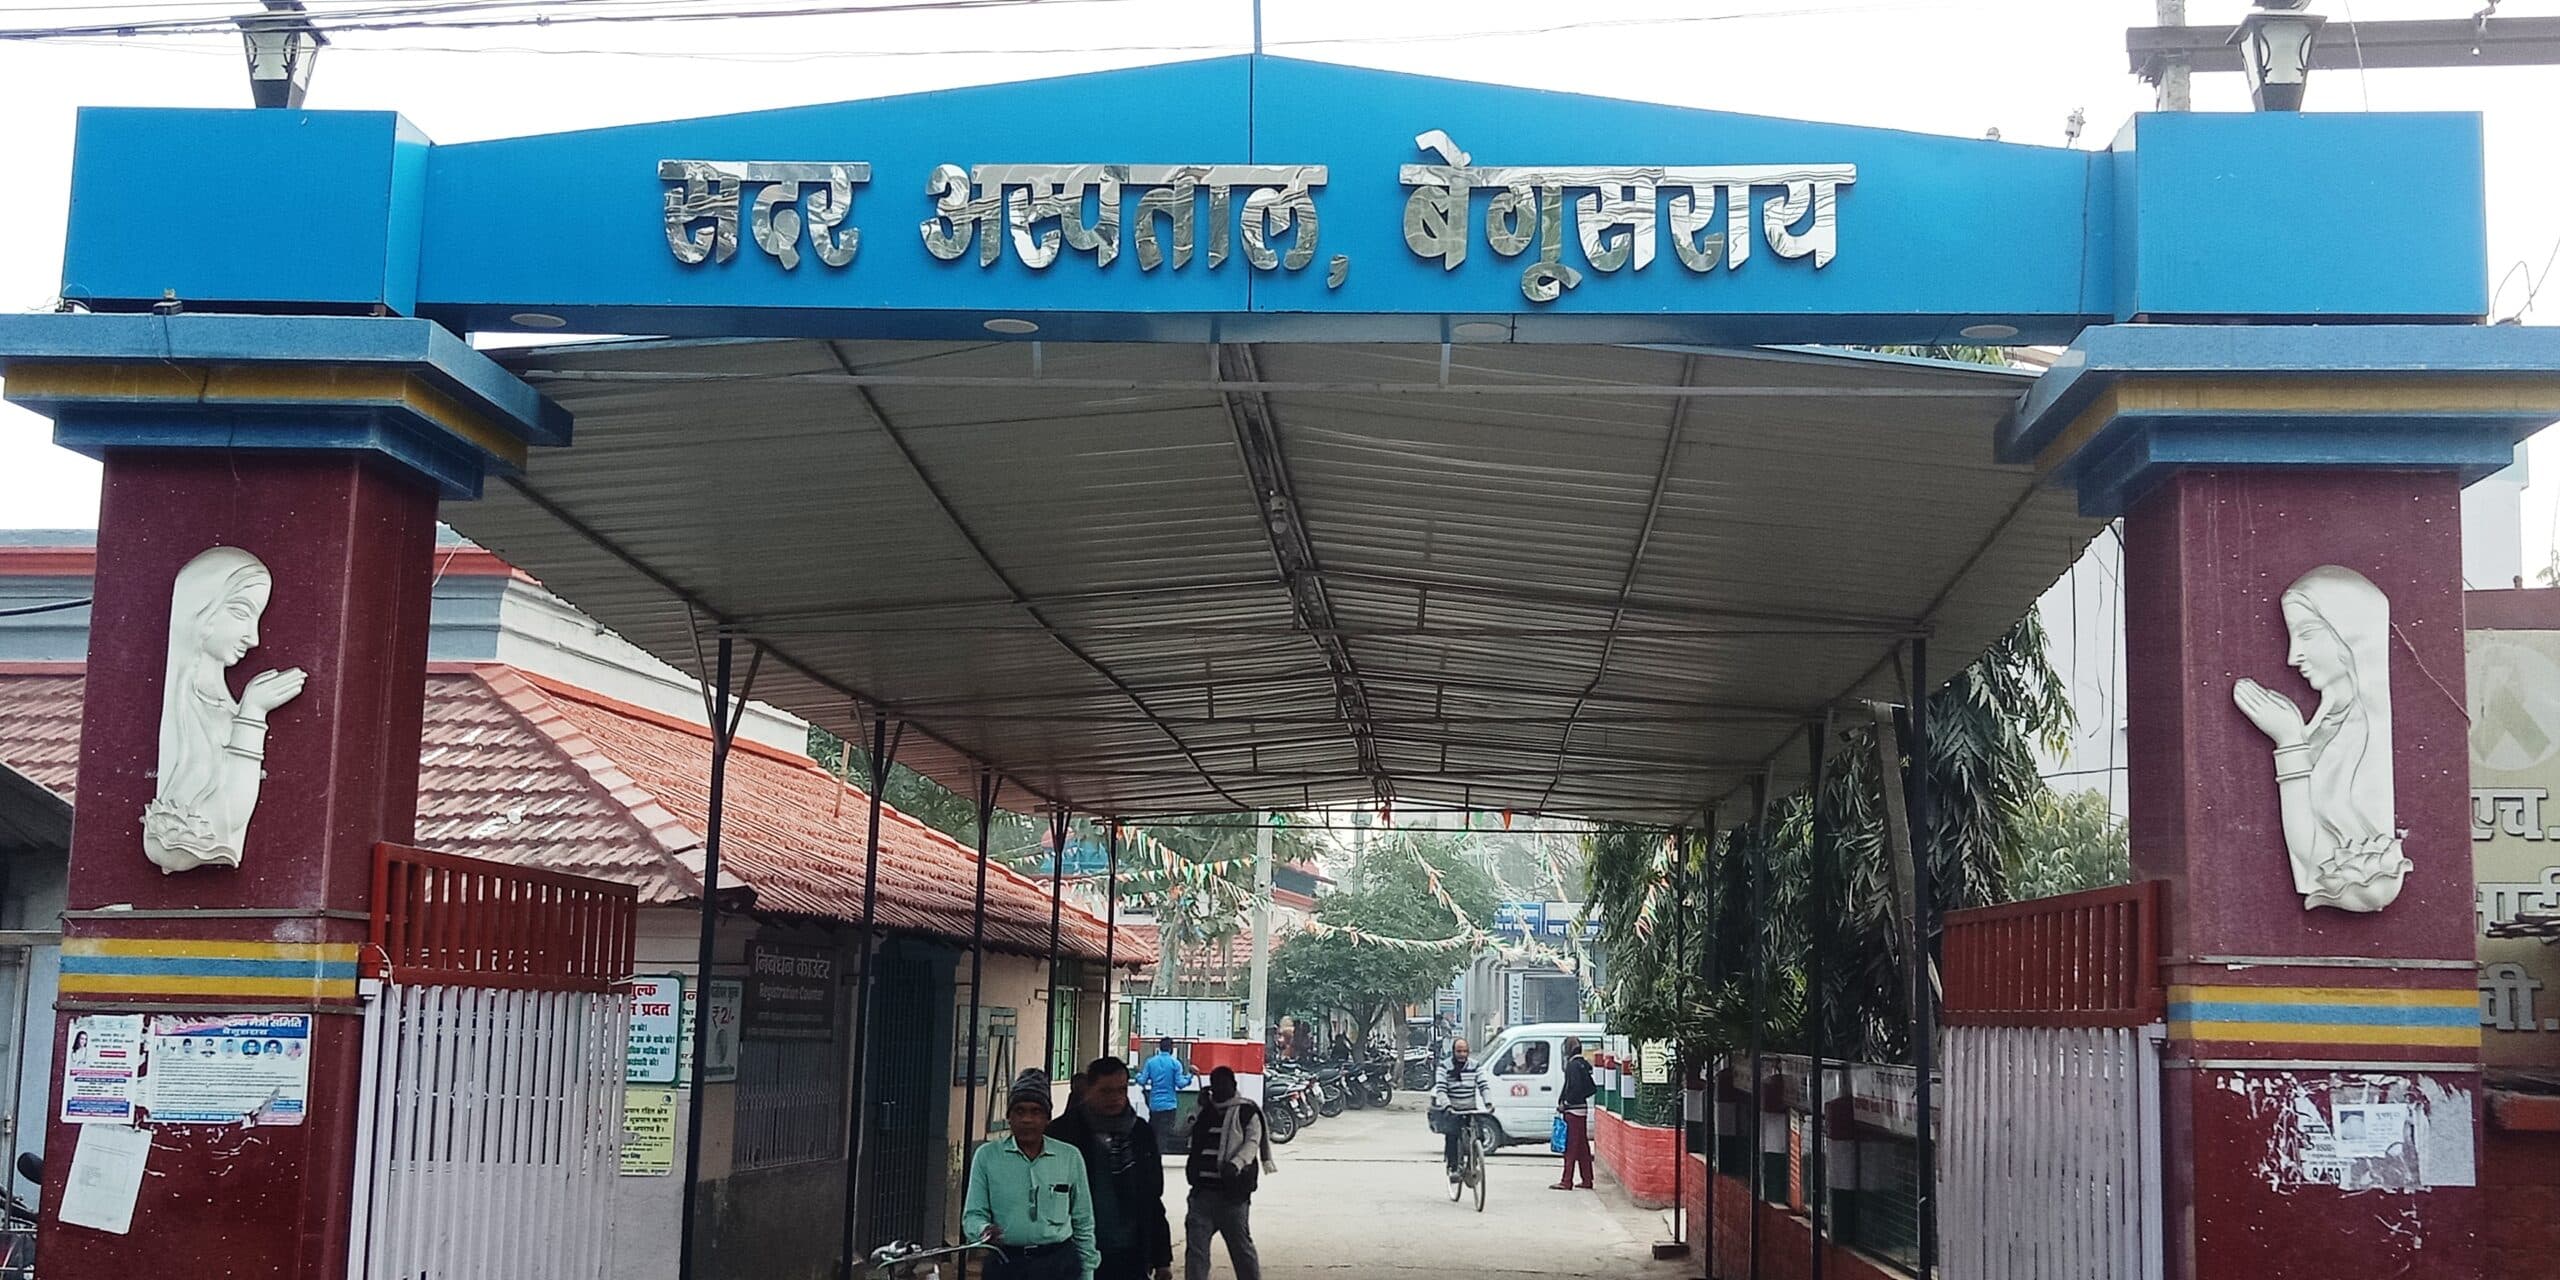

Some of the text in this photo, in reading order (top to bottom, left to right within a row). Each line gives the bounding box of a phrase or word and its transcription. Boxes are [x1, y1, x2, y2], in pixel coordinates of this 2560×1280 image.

[658, 130, 1857, 301] सदर अस्पताल, बेगूसराय
